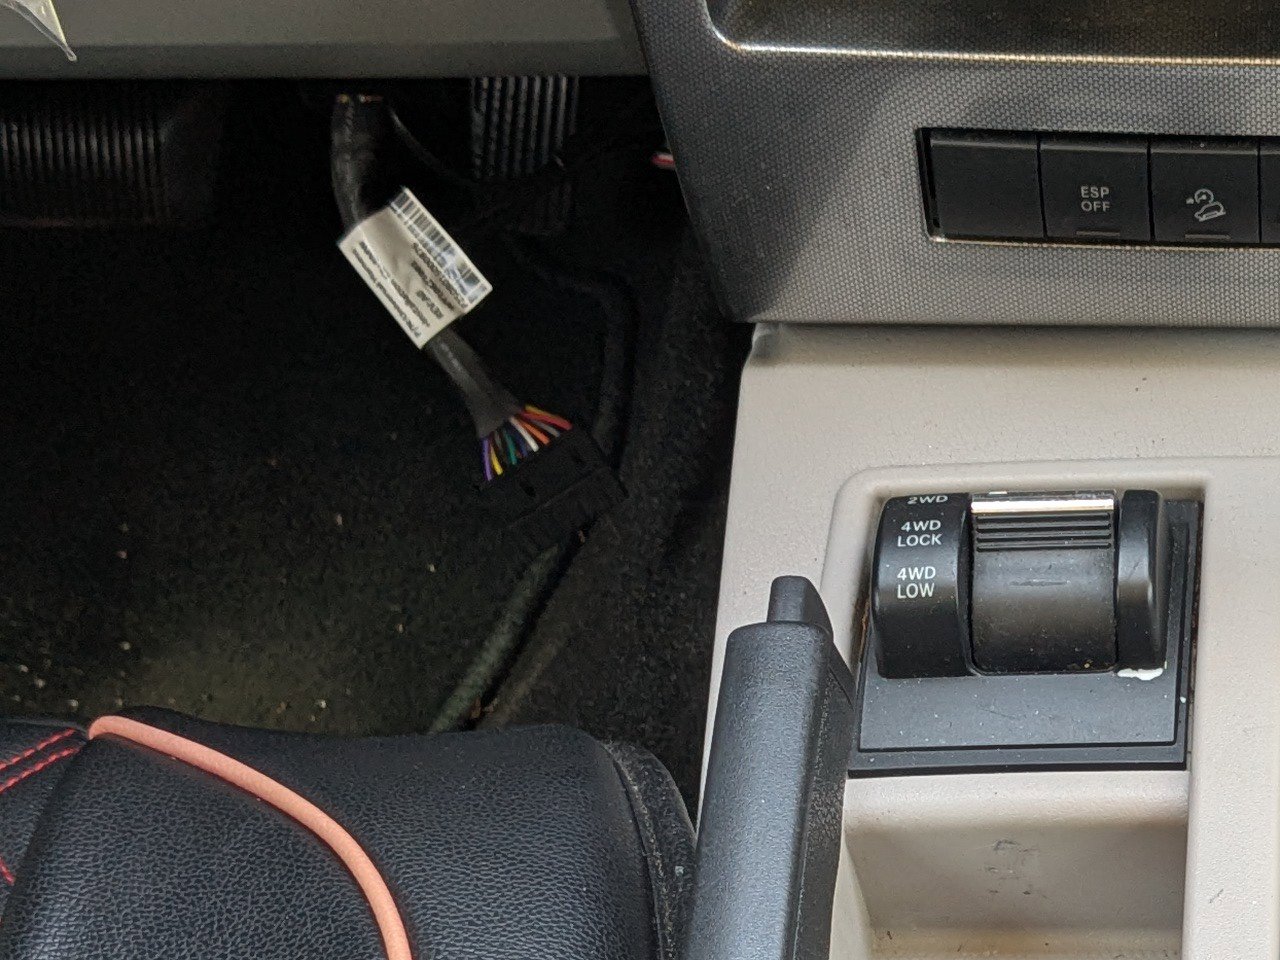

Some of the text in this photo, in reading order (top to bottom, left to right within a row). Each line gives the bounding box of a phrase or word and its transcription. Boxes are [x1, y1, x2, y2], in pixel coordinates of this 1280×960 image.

[1080, 186, 1110, 199] ESP
[1080, 200, 1111, 212] OFF
[907, 495, 948, 505] 2WD
[900, 520, 942, 532] 4WD
[897, 533, 943, 547] LOCK
[897, 566, 936, 581] 4WD
[897, 582, 935, 599] LOW
